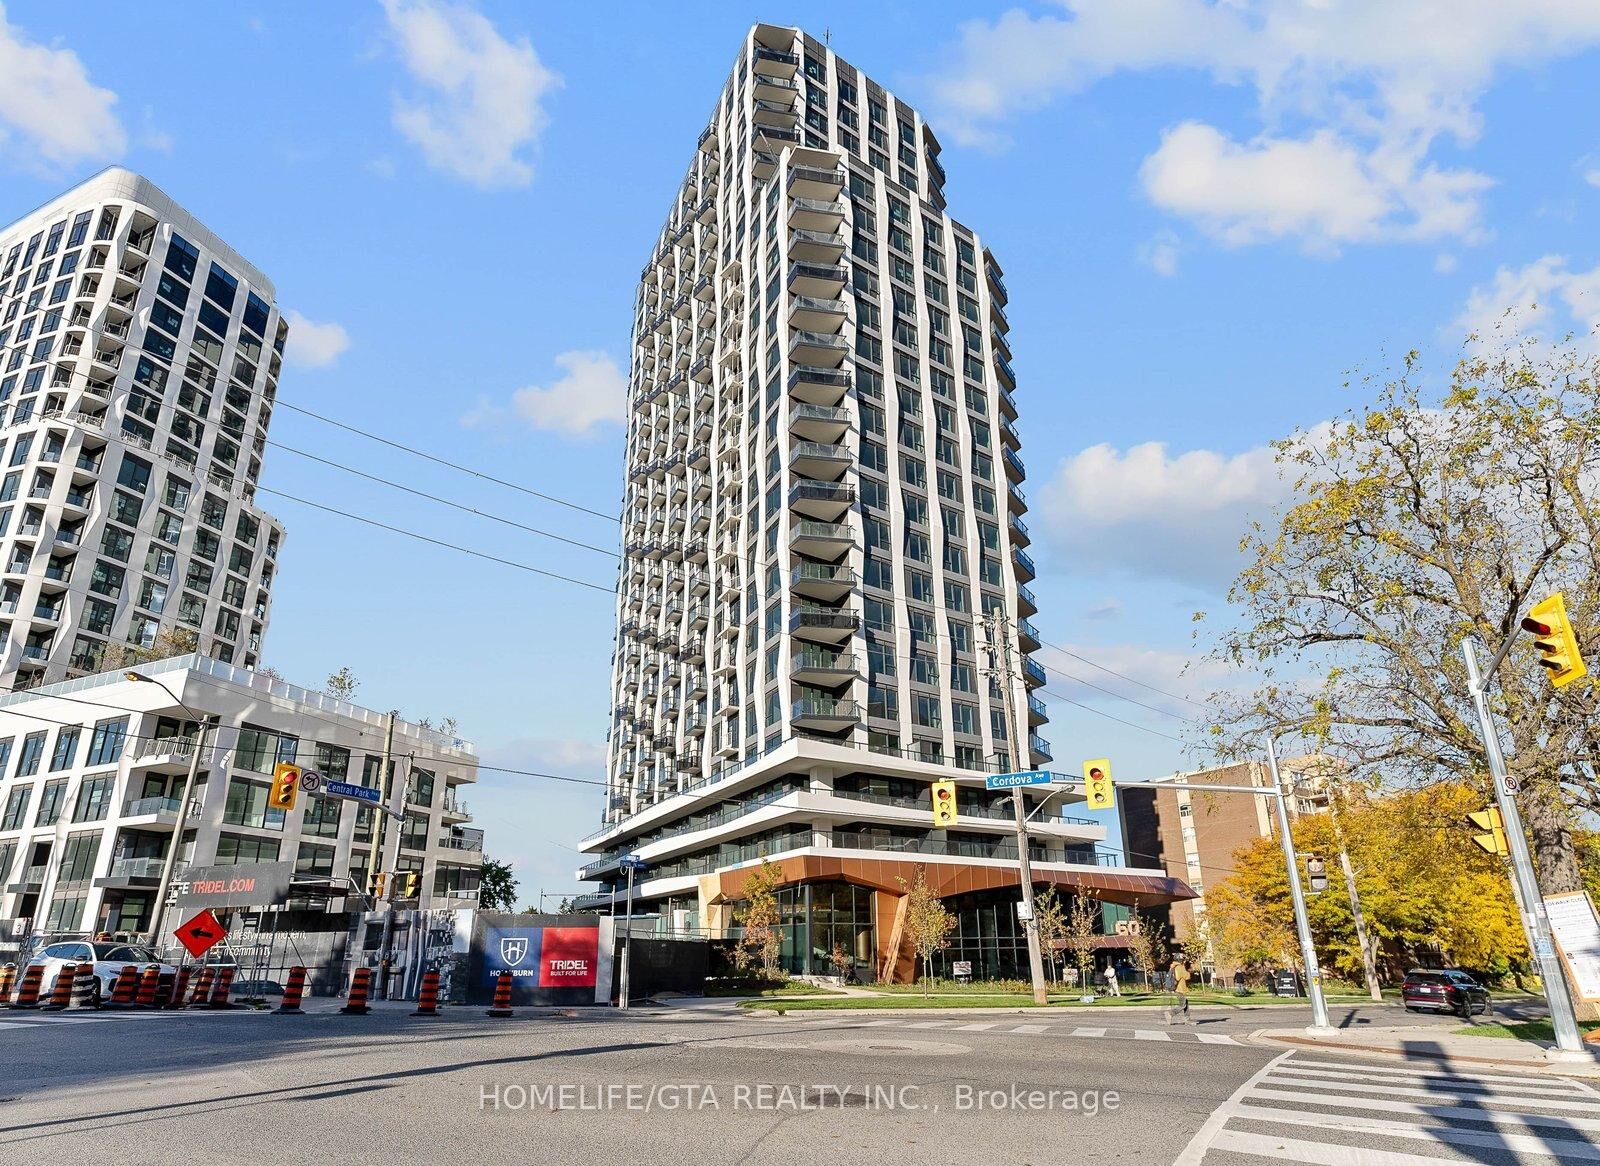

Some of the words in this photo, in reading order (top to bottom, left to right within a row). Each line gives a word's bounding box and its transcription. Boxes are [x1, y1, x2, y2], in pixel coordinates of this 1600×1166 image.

[992, 774, 1033, 787] Cordova
[328, 783, 352, 795] Central
[354, 788, 370, 798] Park
[192, 879, 256, 894] TRIDEL.COM
[15, 924, 21, 934] 3
[550, 960, 588, 970] TRIDEL
[490, 969, 534, 977] HOBURN
